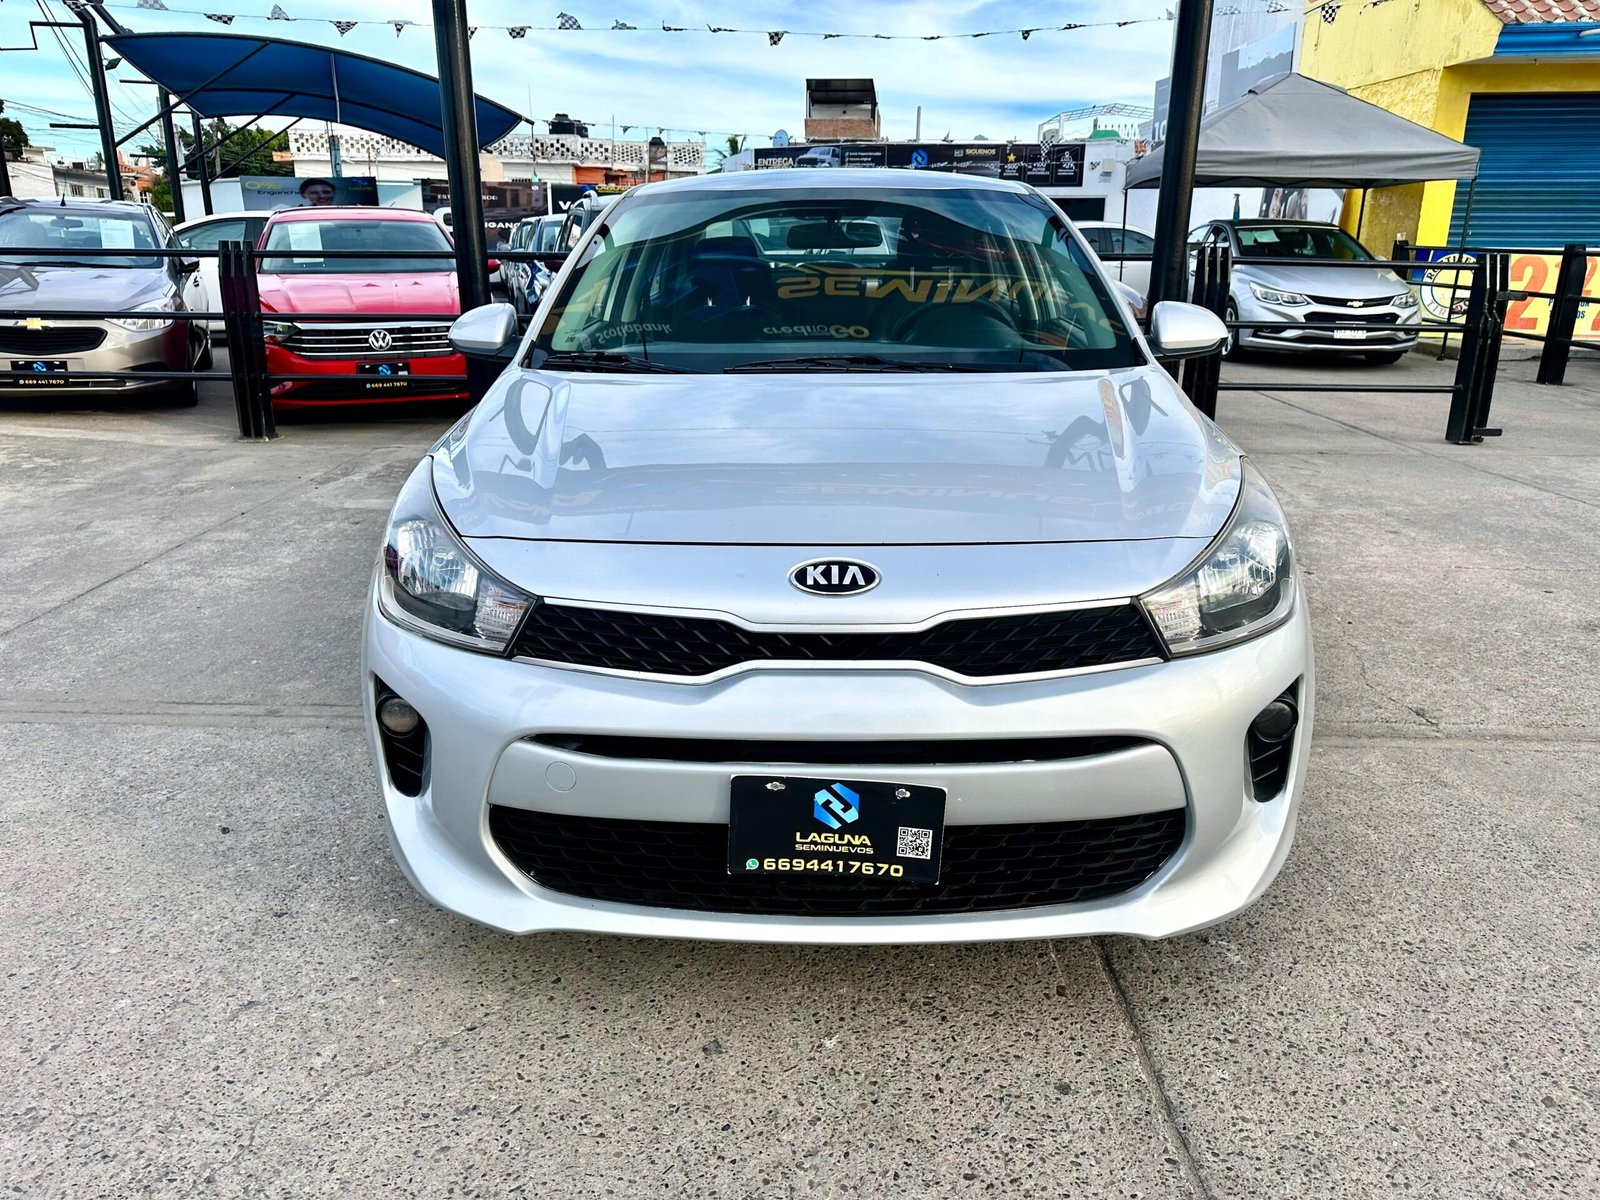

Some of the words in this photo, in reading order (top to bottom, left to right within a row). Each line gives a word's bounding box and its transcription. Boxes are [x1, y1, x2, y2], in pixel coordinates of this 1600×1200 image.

[758, 157, 794, 166] ENTREGA
[805, 564, 866, 586] KIA
[795, 831, 872, 846] LAGUNA
[795, 843, 874, 855] SEMINUEVOS
[763, 858, 904, 878] 6694417670
